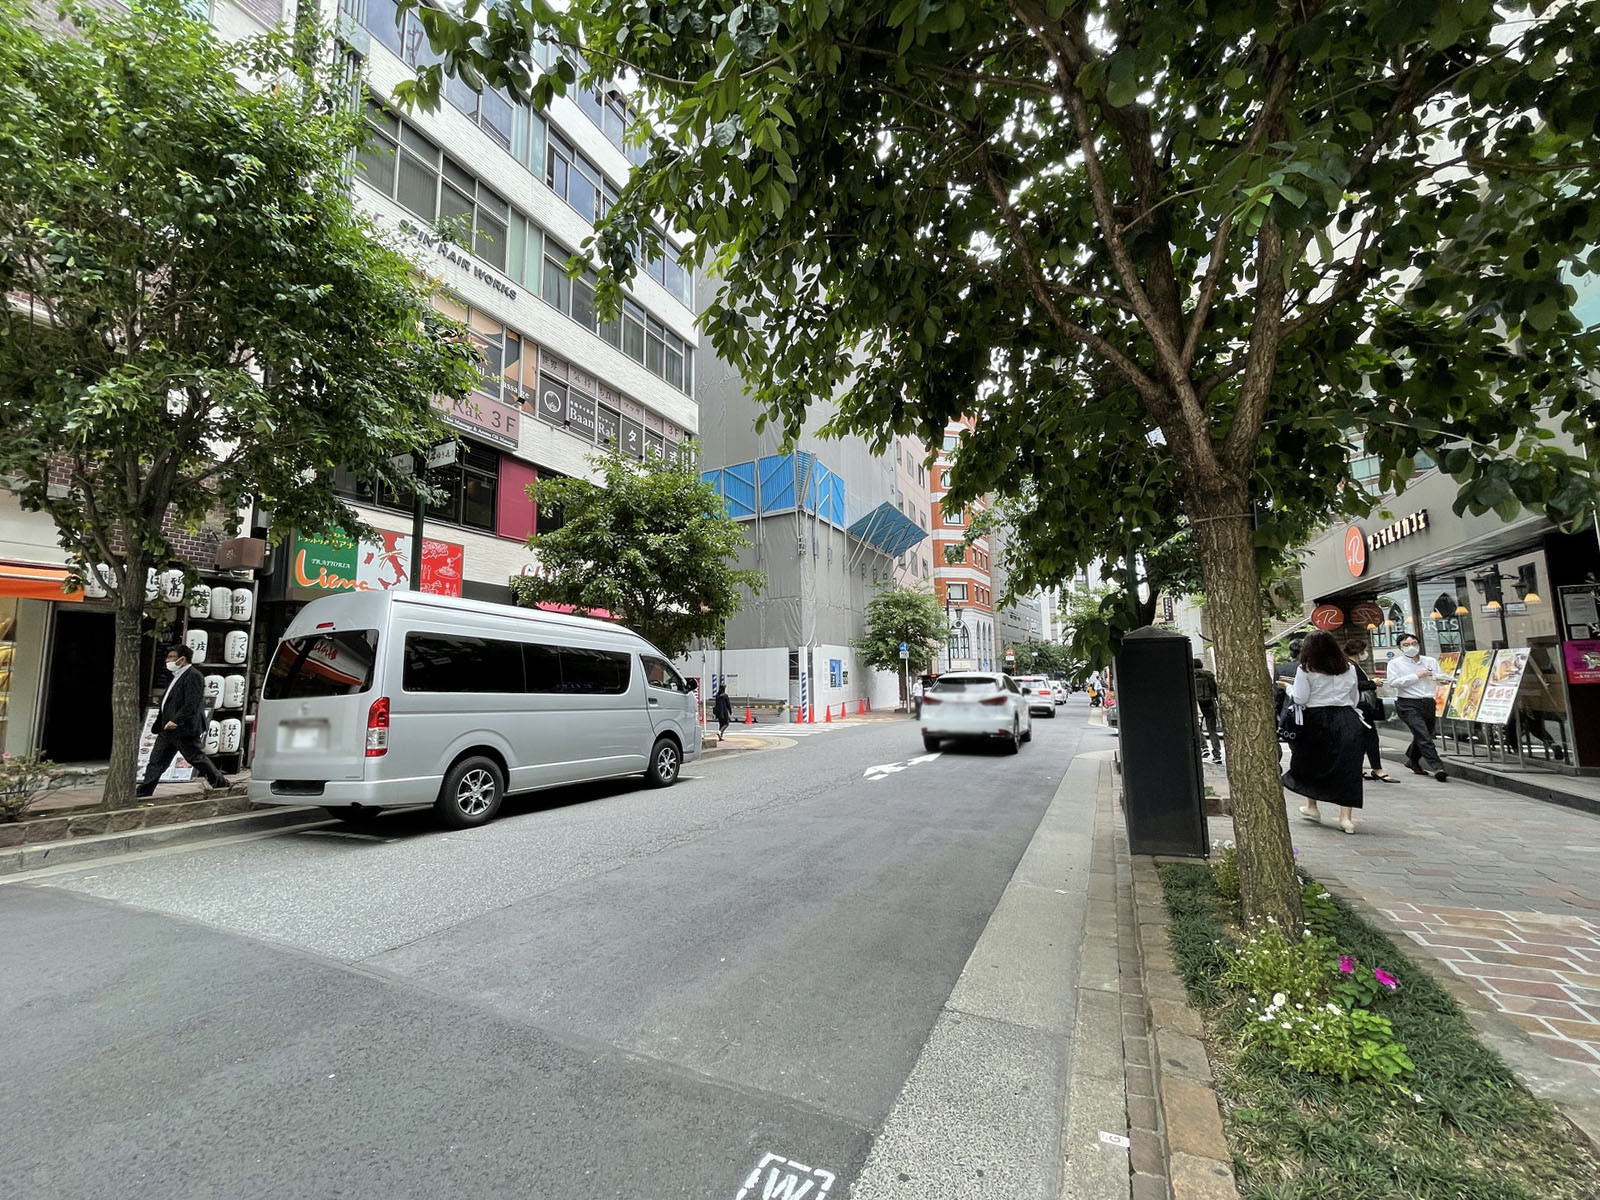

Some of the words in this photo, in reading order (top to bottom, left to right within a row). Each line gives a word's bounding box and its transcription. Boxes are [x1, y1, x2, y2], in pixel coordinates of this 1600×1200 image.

[437, 242, 471, 272] HAIR
[473, 264, 518, 301] WORKS
[452, 398, 483, 423] Rak
[570, 406, 595, 430] Baan
[598, 421, 617, 438] Rak
[1367, 509, 1428, 551] サンマルクカフェ
[311, 558, 352, 569] TRATTORIA
[234, 595, 248, 616] 砂肝
[196, 641, 207, 652] 皮
[236, 635, 248, 660] つくね
[208, 727, 219, 750] はつ
